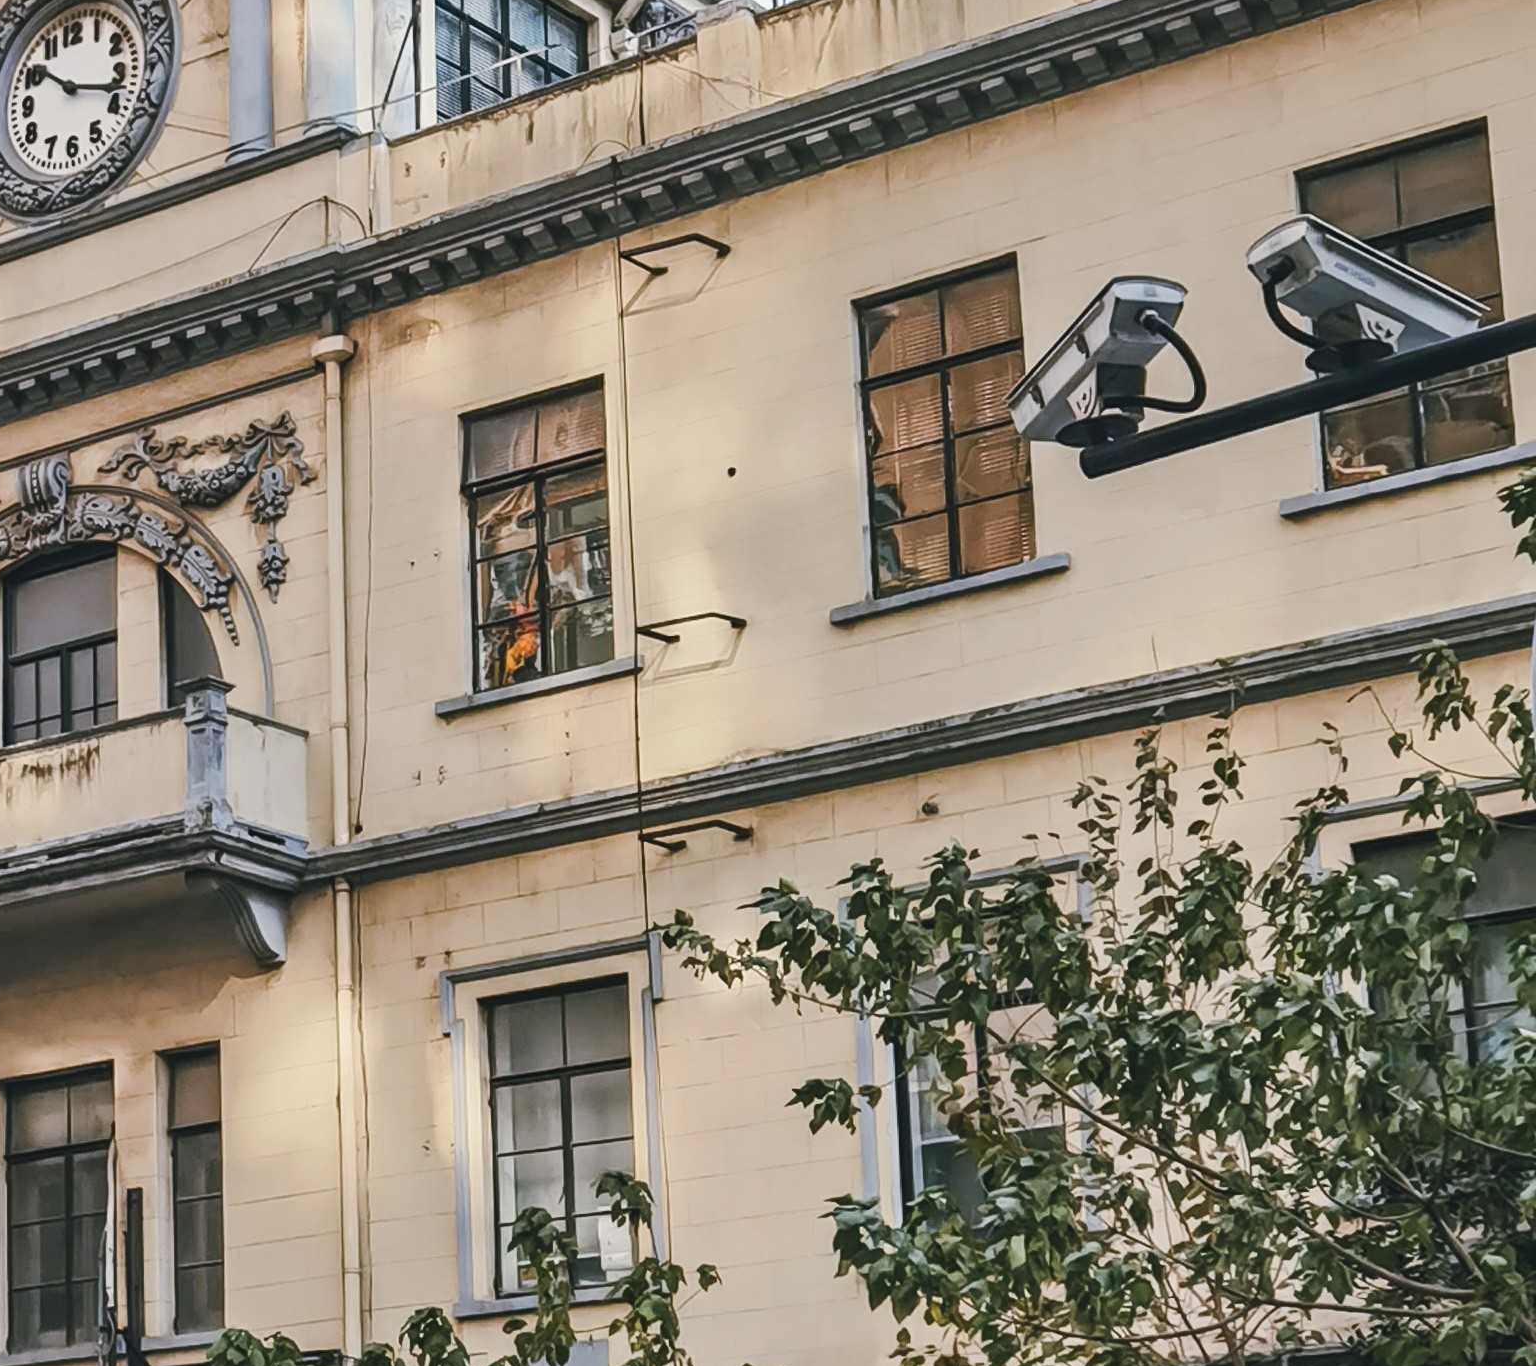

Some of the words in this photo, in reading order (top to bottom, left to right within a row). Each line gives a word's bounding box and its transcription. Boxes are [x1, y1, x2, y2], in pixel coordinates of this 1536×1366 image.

[63, 21, 83, 48] 12
[94, 18, 100, 43] 1
[44, 35, 58, 60] 11
[109, 32, 123, 57] 2
[22, 95, 35, 118] 9
[107, 92, 121, 115] 4
[24, 121, 38, 144] 8
[89, 119, 103, 144] 5
[44, 135, 58, 159] 7
[66, 135, 79, 158] 6
